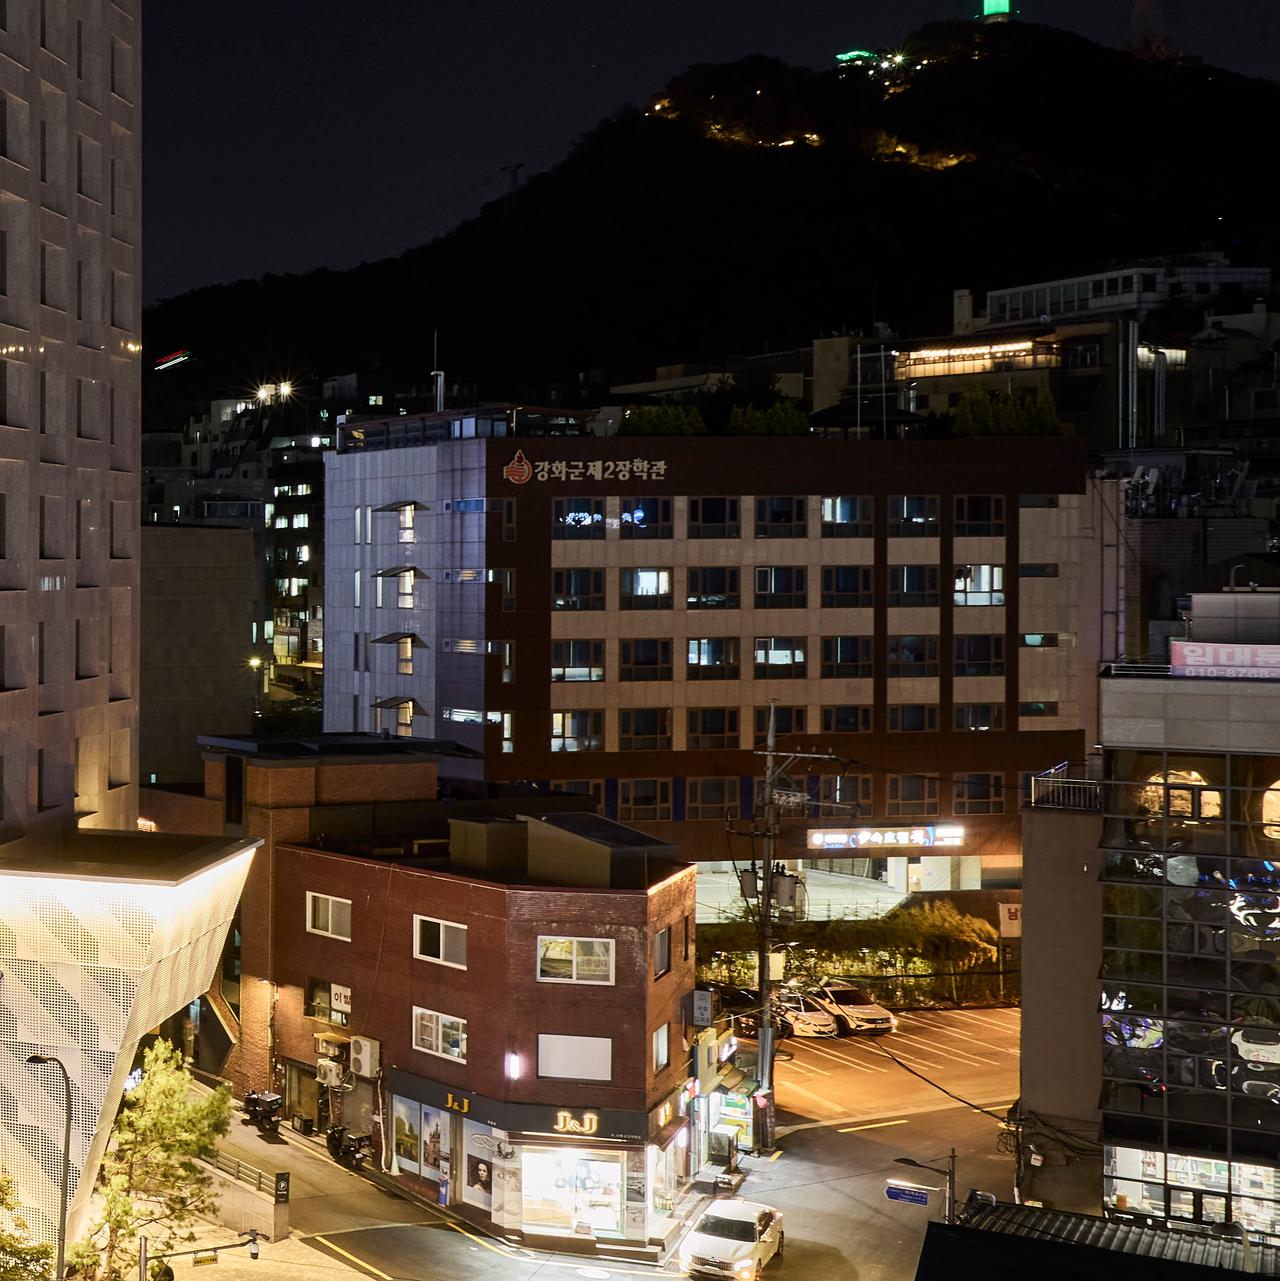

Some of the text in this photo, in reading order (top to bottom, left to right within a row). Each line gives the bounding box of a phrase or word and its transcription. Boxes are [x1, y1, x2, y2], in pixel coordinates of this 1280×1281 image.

[534, 458, 667, 481] 강화군제2장학관
[444, 1092, 470, 1114] J&J
[553, 1110, 599, 1134] J&J
